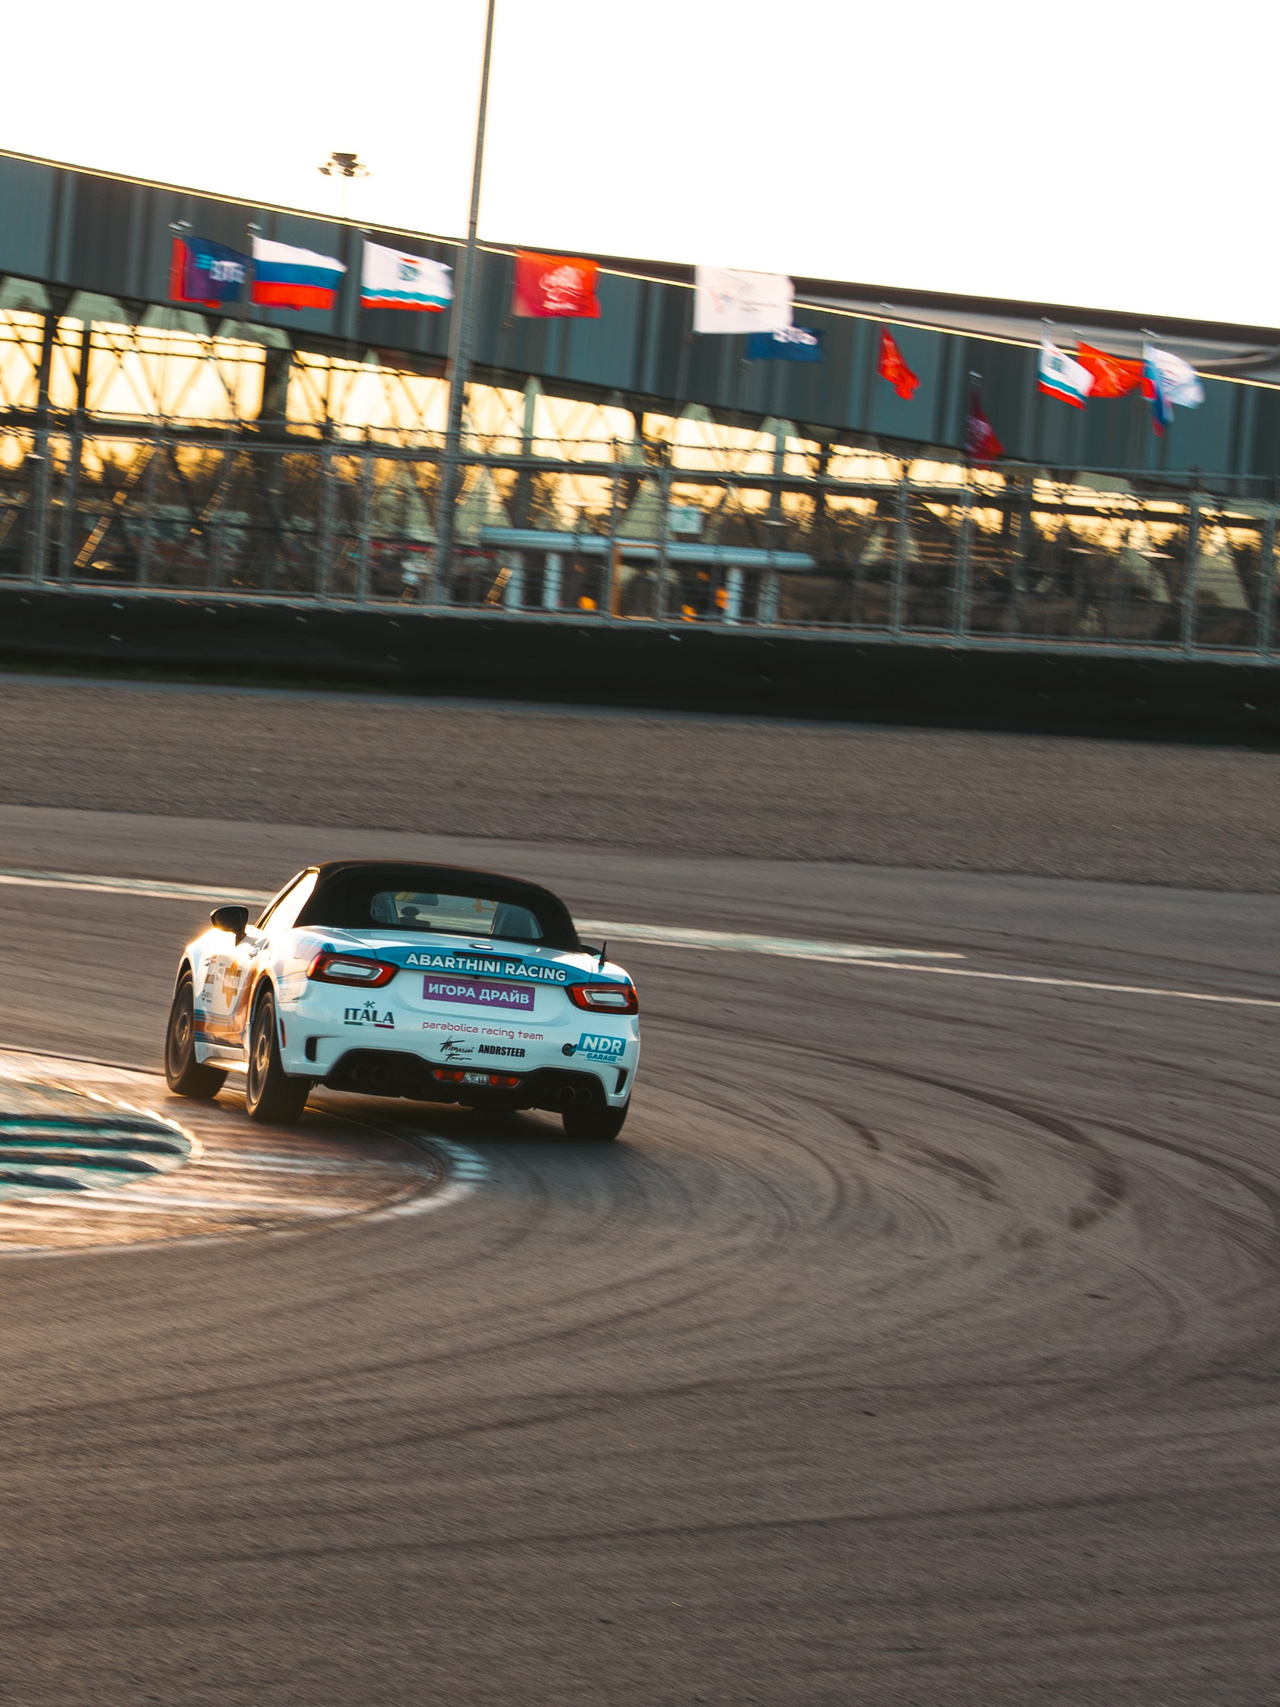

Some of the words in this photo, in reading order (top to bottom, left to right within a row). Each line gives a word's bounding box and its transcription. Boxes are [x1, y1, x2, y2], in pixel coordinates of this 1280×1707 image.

[406, 953, 500, 973] ABARTHINI
[505, 963, 567, 981] RACING
[428, 983, 476, 998] ИГОРА
[479, 989, 530, 1004] ДРАЙВ
[344, 1007, 395, 1024] ITALA
[422, 1020, 479, 1033] parabolica
[481, 1027, 515, 1040] racing
[517, 1030, 544, 1041] team
[478, 1044, 526, 1058] ANDRSTEER
[582, 1036, 622, 1053] NDR
[586, 1053, 617, 1062] GARAGE
